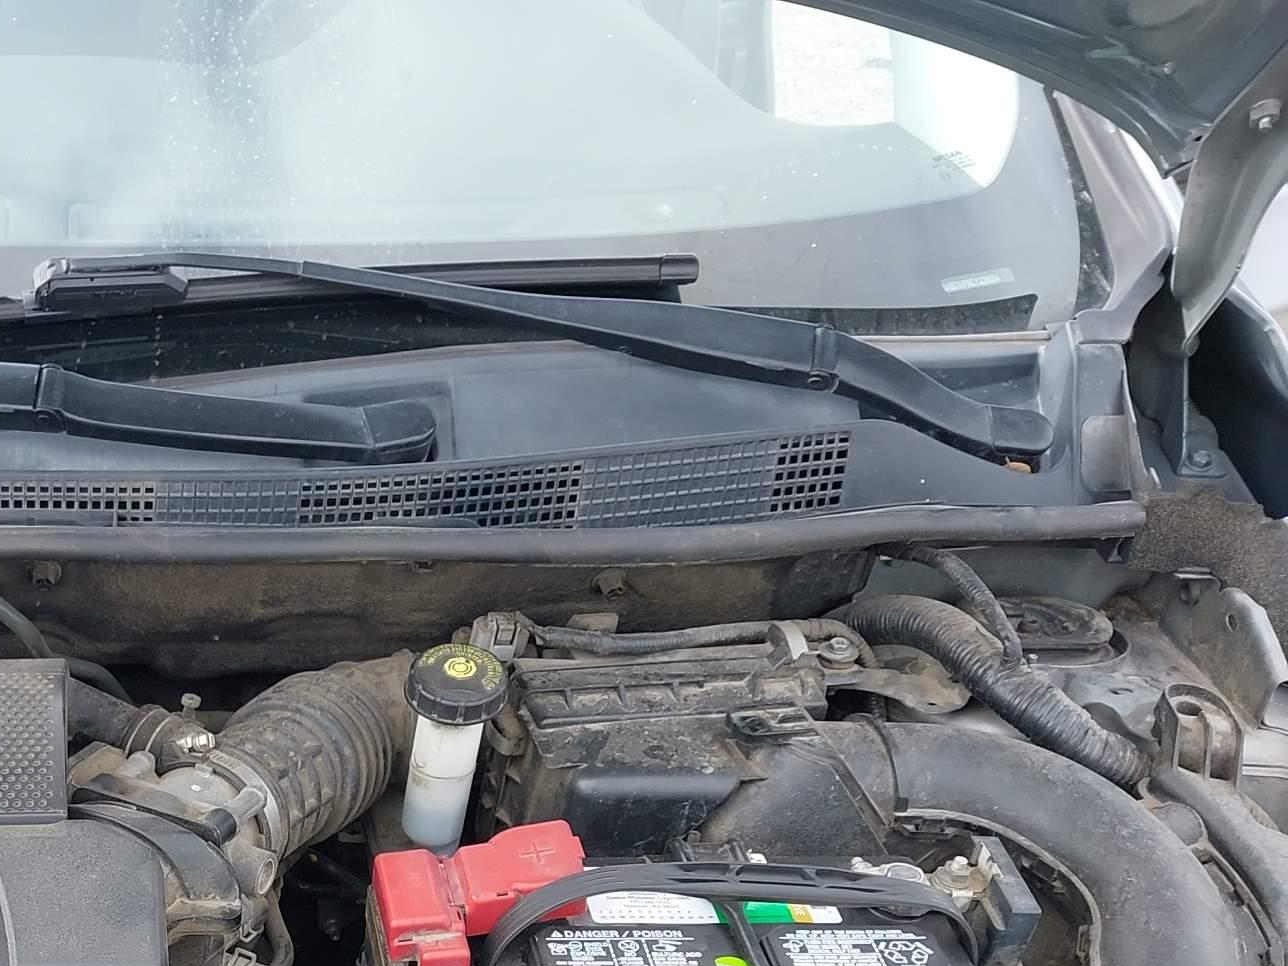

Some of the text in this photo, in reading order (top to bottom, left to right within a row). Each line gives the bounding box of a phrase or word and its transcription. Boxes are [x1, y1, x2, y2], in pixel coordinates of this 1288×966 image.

[564, 930, 684, 938] DANGER / POISON
